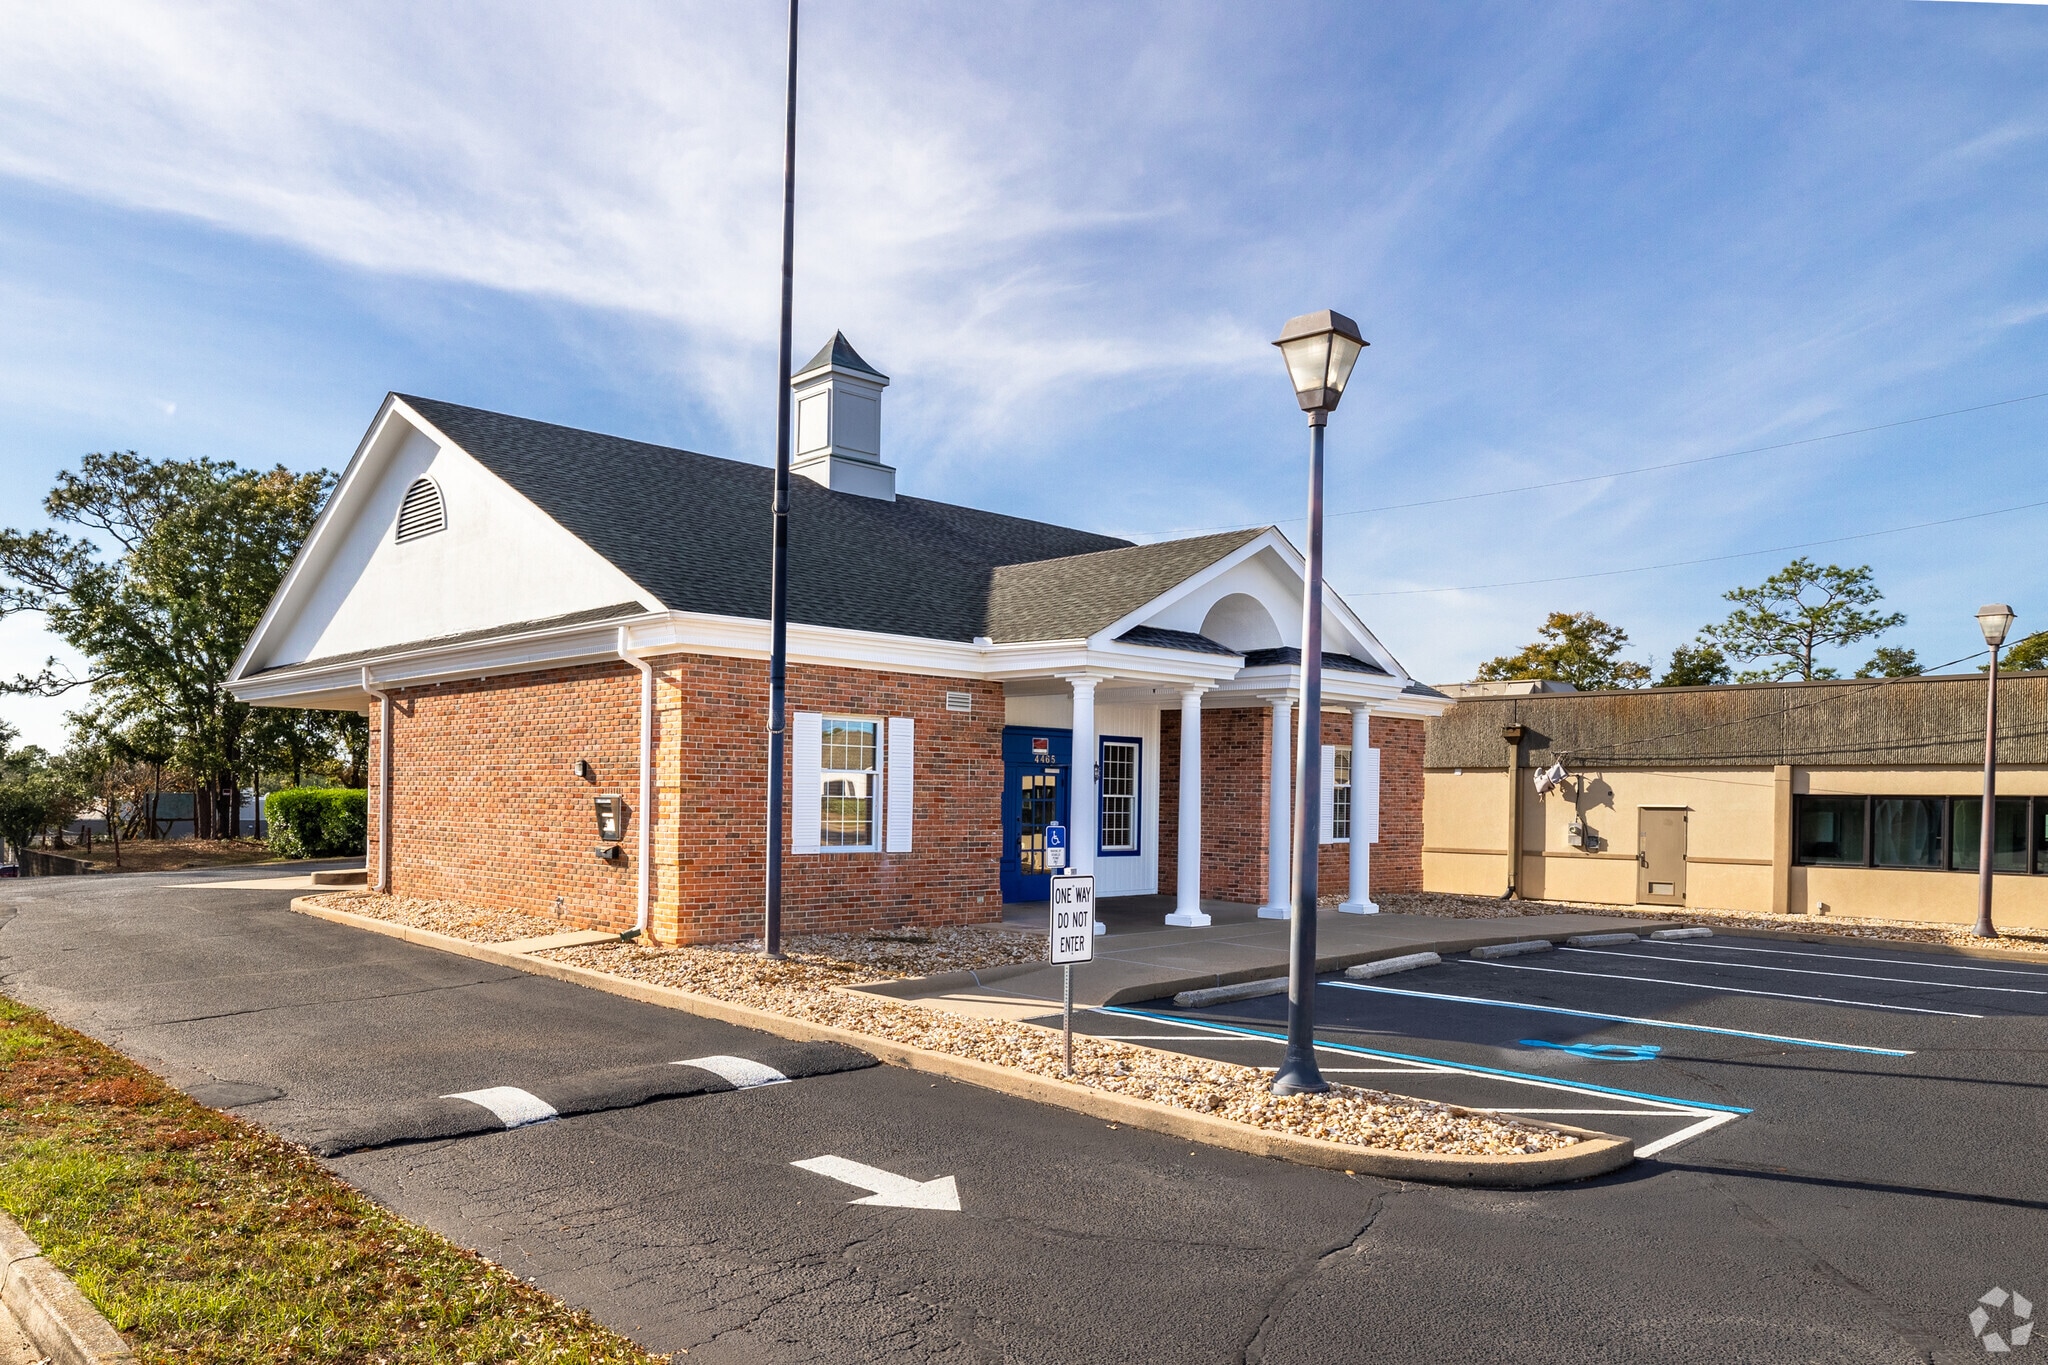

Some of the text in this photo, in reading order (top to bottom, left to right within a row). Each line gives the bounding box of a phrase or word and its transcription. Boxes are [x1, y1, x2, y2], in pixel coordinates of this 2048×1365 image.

[1034, 755, 1056, 764] 4465
[1055, 886, 1091, 904] ONE WAY
[1057, 911, 1088, 929] DO NOT
[1060, 936, 1085, 953] ENTER
